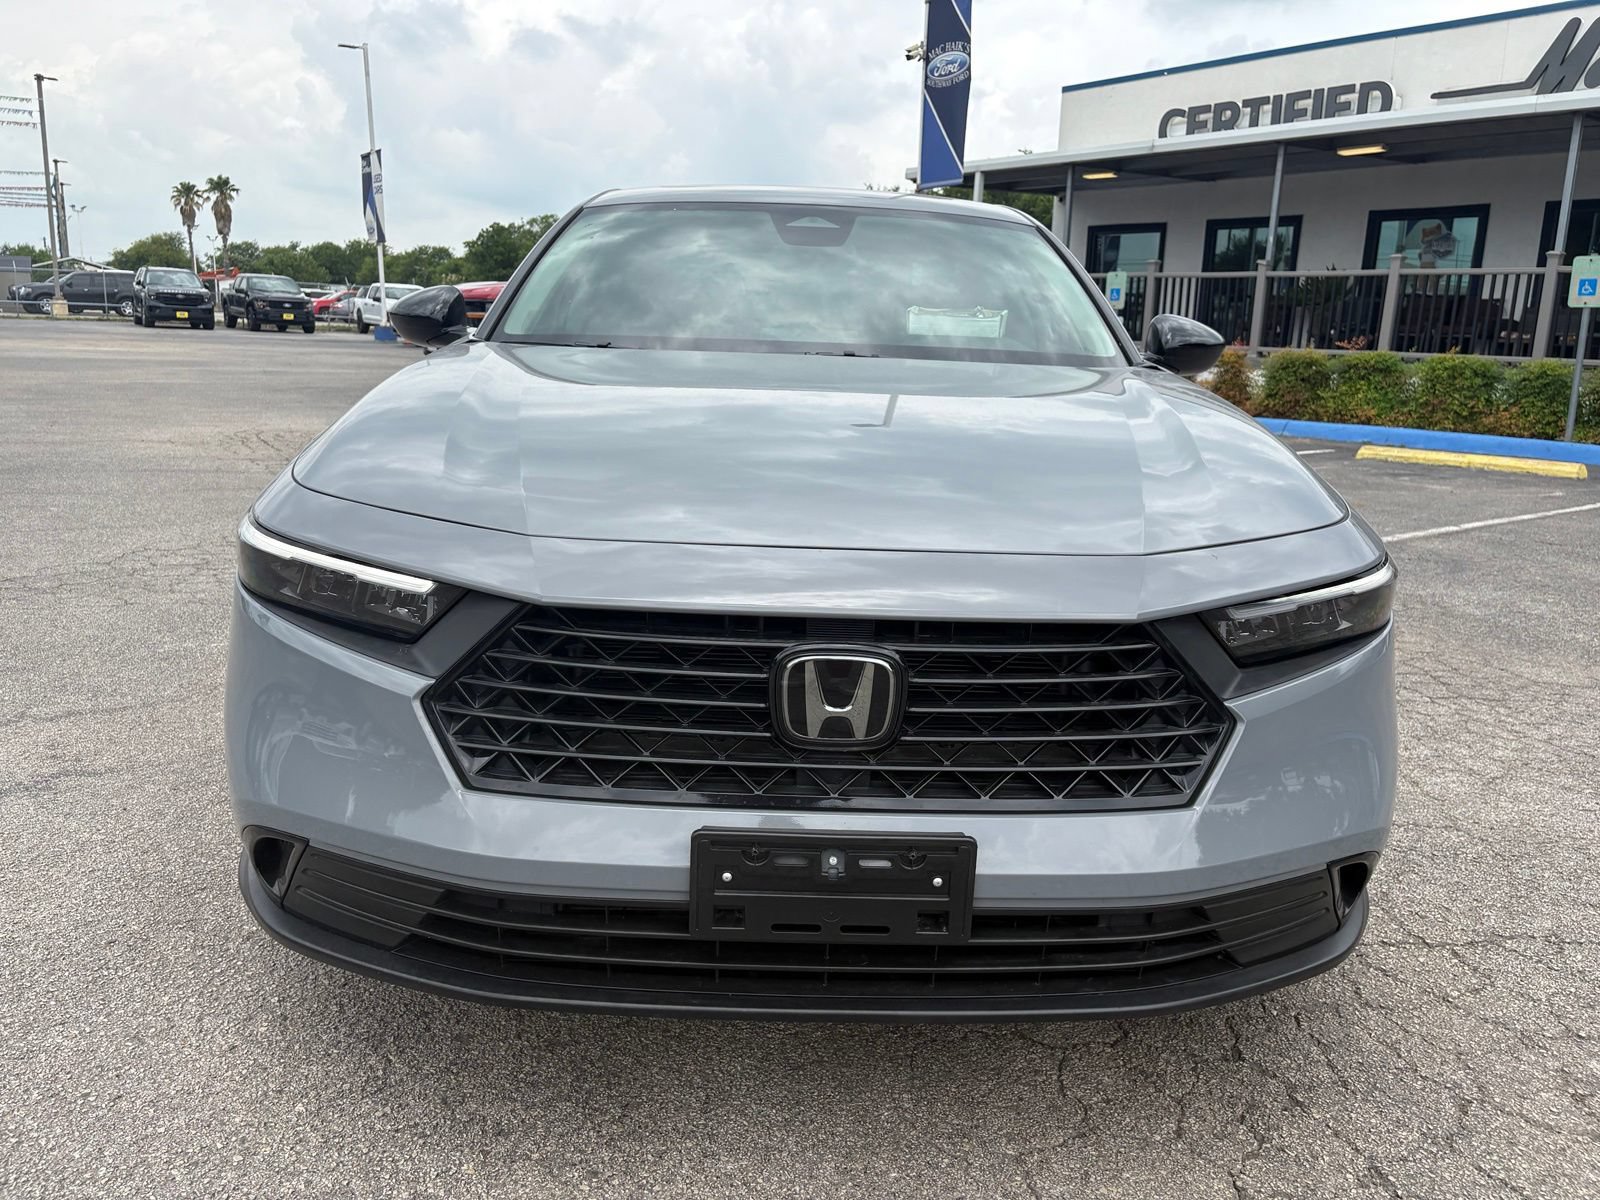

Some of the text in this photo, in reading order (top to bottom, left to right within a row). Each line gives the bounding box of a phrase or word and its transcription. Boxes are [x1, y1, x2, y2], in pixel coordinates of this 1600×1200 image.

[928, 44, 945, 60] MAC
[934, 55, 960, 77] Ford
[952, 71, 969, 84] FORD
[1158, 81, 1393, 139] CERTIFIED
